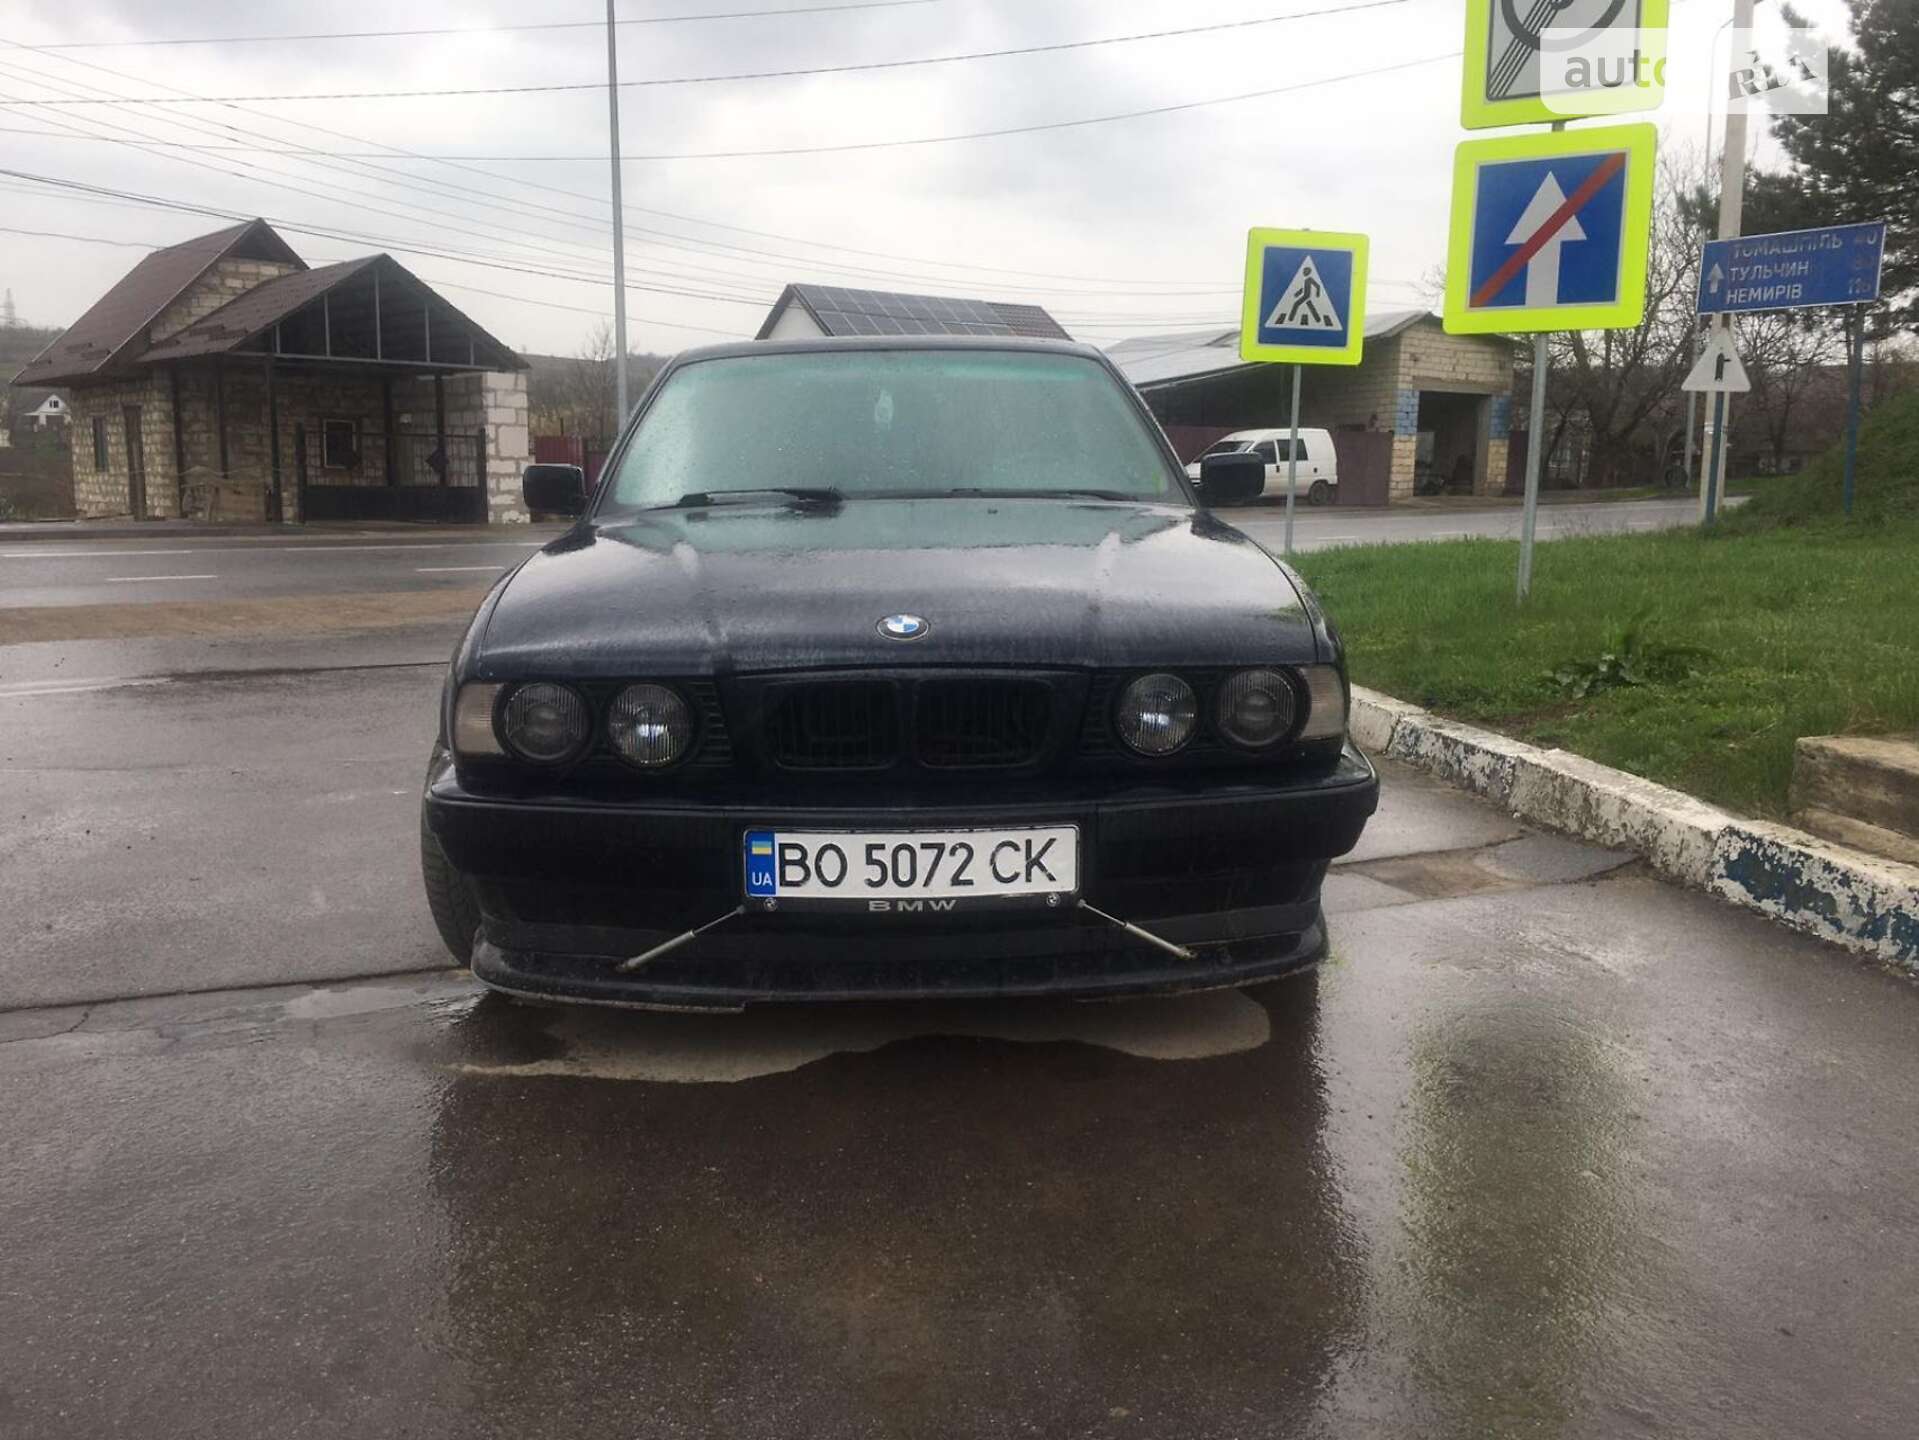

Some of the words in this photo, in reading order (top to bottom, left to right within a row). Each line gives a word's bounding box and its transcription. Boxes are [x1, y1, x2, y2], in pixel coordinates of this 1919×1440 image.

[1731, 262, 1809, 281] ТУЛЬЧИН
[1727, 284, 1802, 305] НЕМИРІВ
[752, 872, 773, 887] UA
[779, 843, 848, 888] BO
[864, 842, 975, 888] 5072
[989, 838, 1057, 884] CK
[868, 900, 956, 912] BMW
